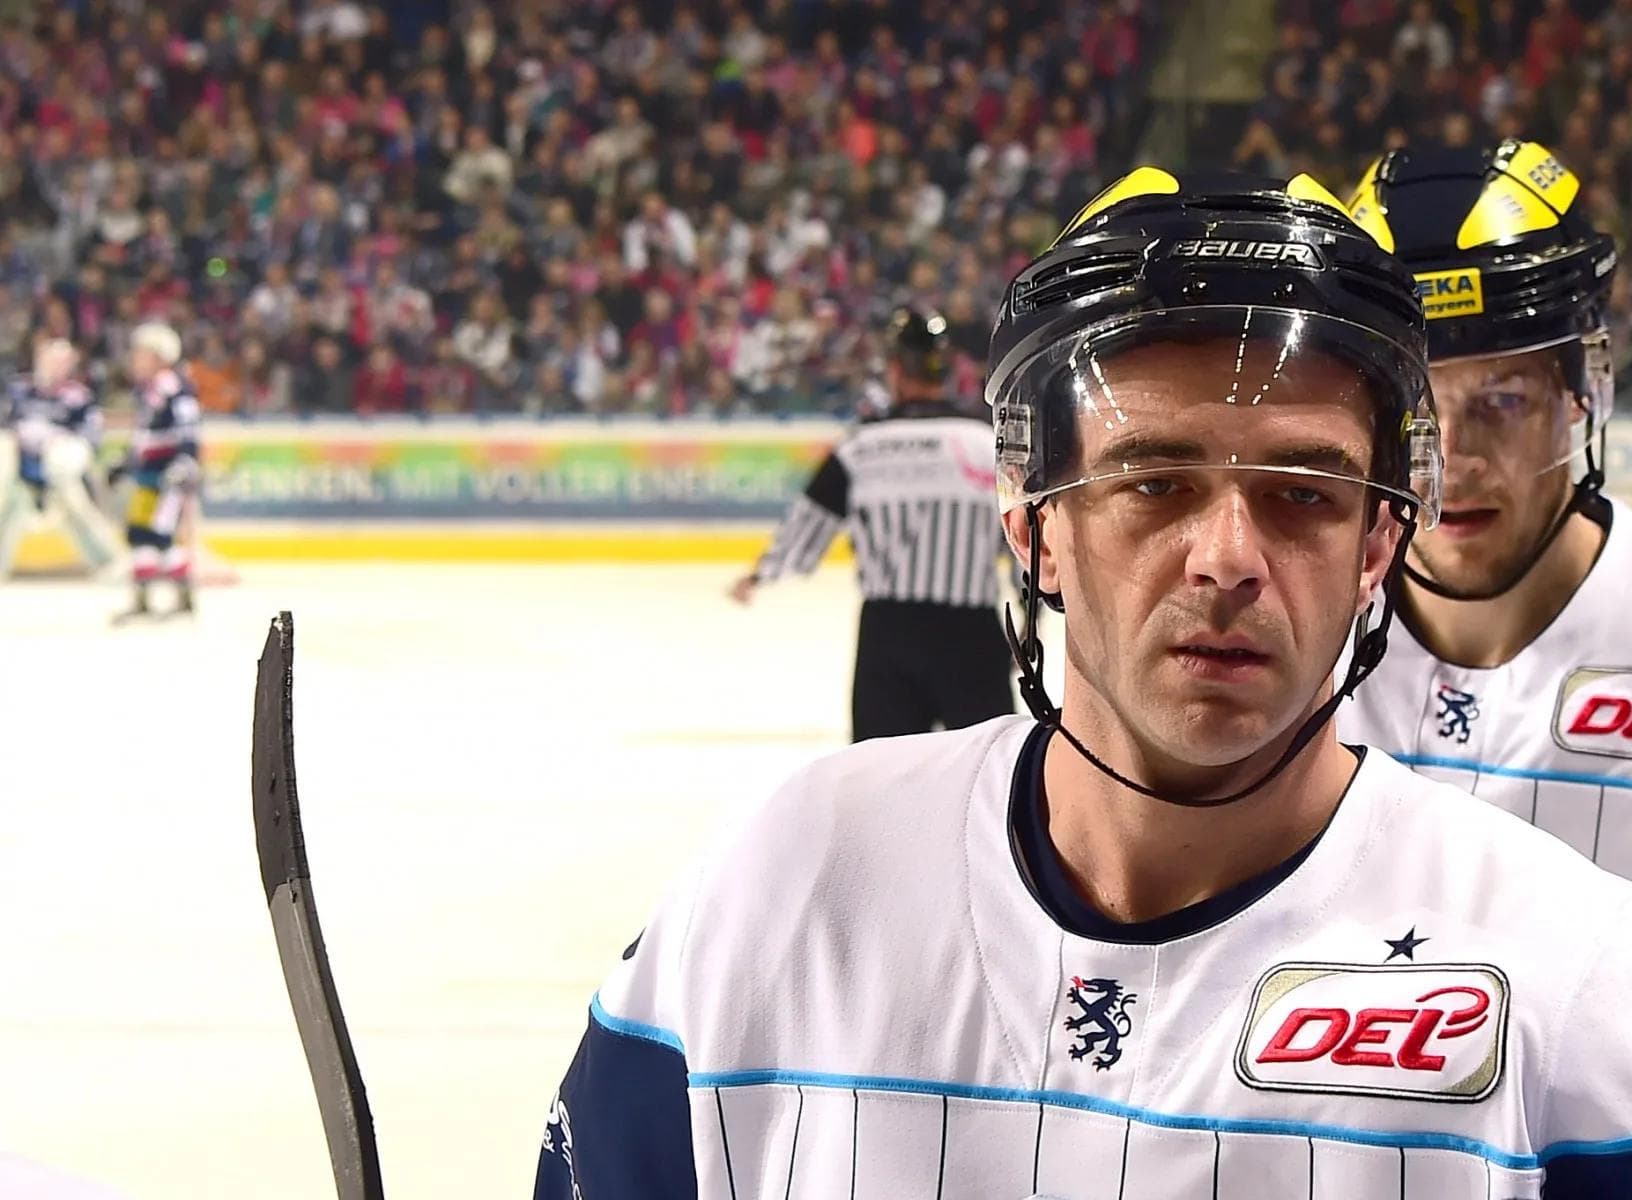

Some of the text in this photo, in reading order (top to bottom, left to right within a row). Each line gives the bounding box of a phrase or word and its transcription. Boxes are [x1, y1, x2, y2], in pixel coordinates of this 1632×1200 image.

[1169, 239, 1312, 265] BAUER
[1414, 275, 1474, 297] EKA
[1256, 986, 1490, 1072] DEL
